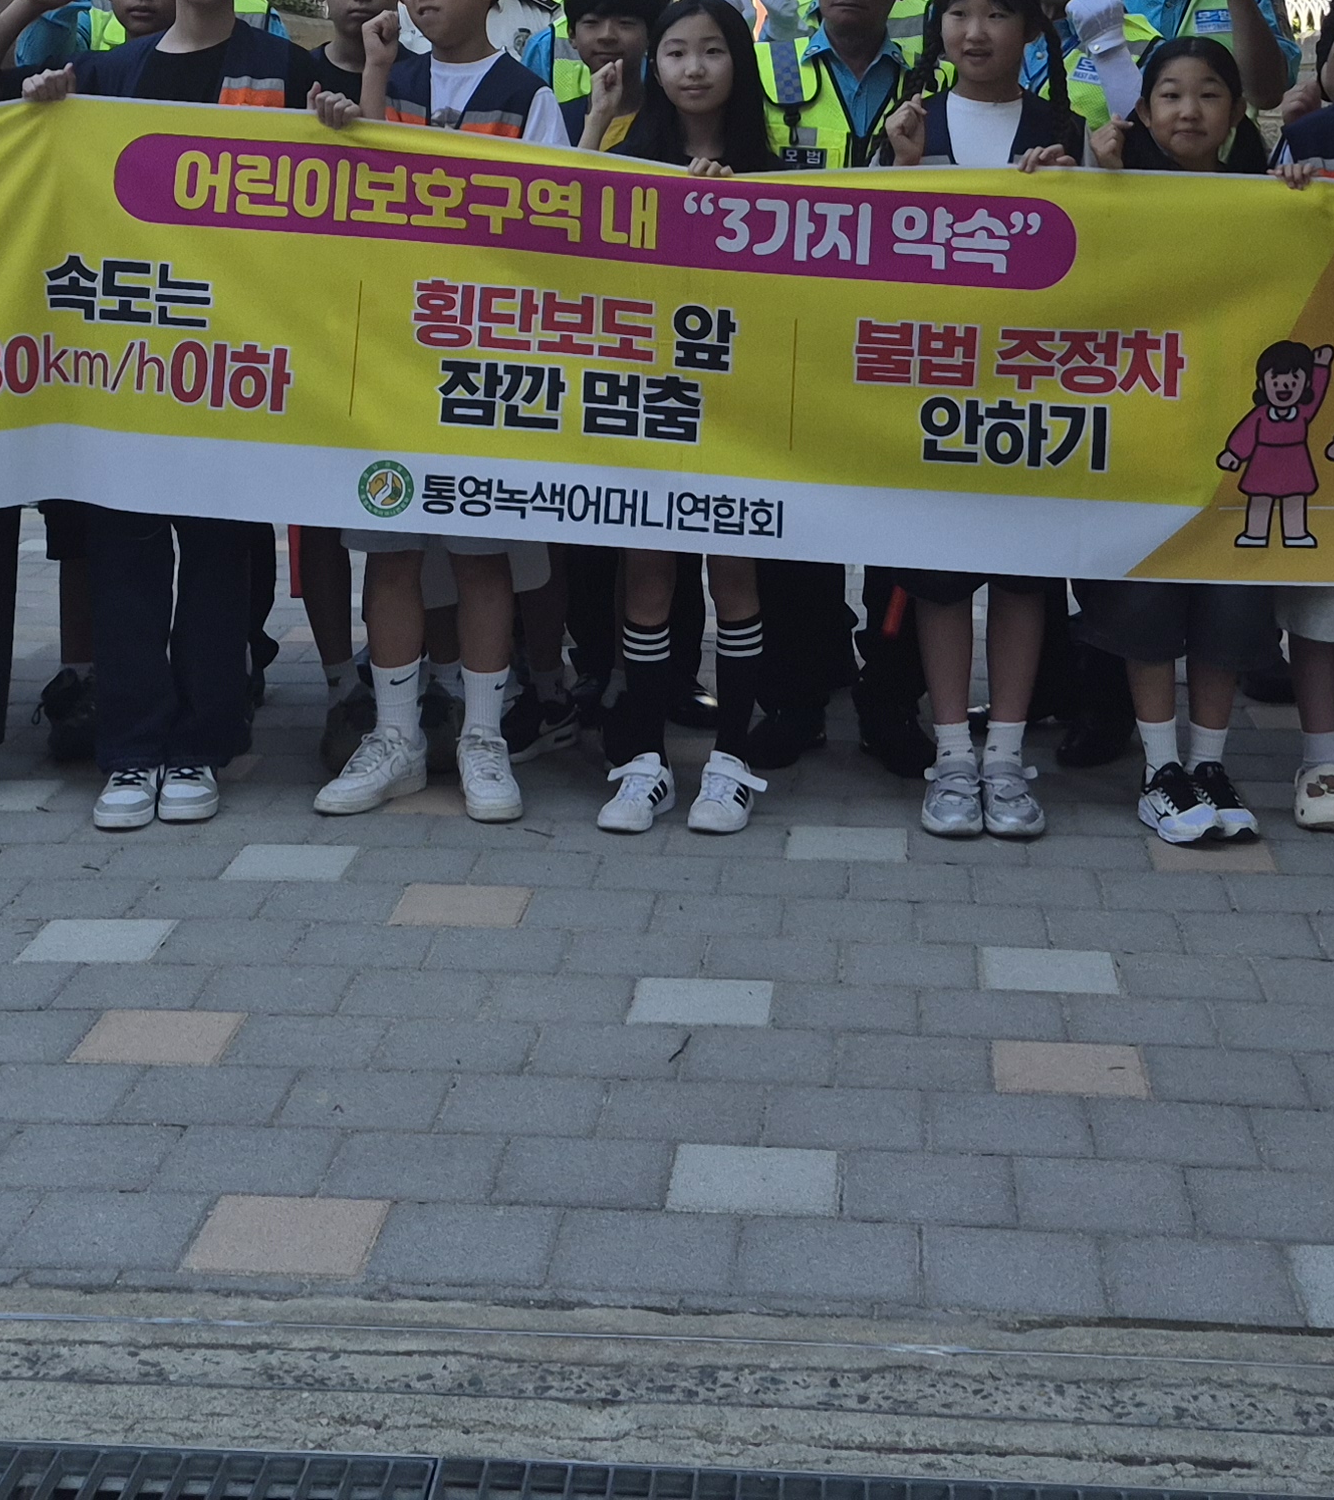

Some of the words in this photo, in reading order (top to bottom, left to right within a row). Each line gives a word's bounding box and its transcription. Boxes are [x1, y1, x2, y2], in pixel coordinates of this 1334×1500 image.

[173, 148, 583, 244] 어린이보호구역
[600, 184, 659, 250] 내
[45, 254, 211, 329] 속도는
[412, 278, 656, 361] 횡단보도
[673, 304, 737, 373] 앞
[854, 318, 979, 390] 불법
[995, 327, 1185, 399] 주정차
[437, 359, 565, 431] 잠깐
[581, 367, 703, 444] 멈춤
[919, 395, 1111, 473] 안하기
[422, 473, 784, 539] 통영녹색어머니연합회
